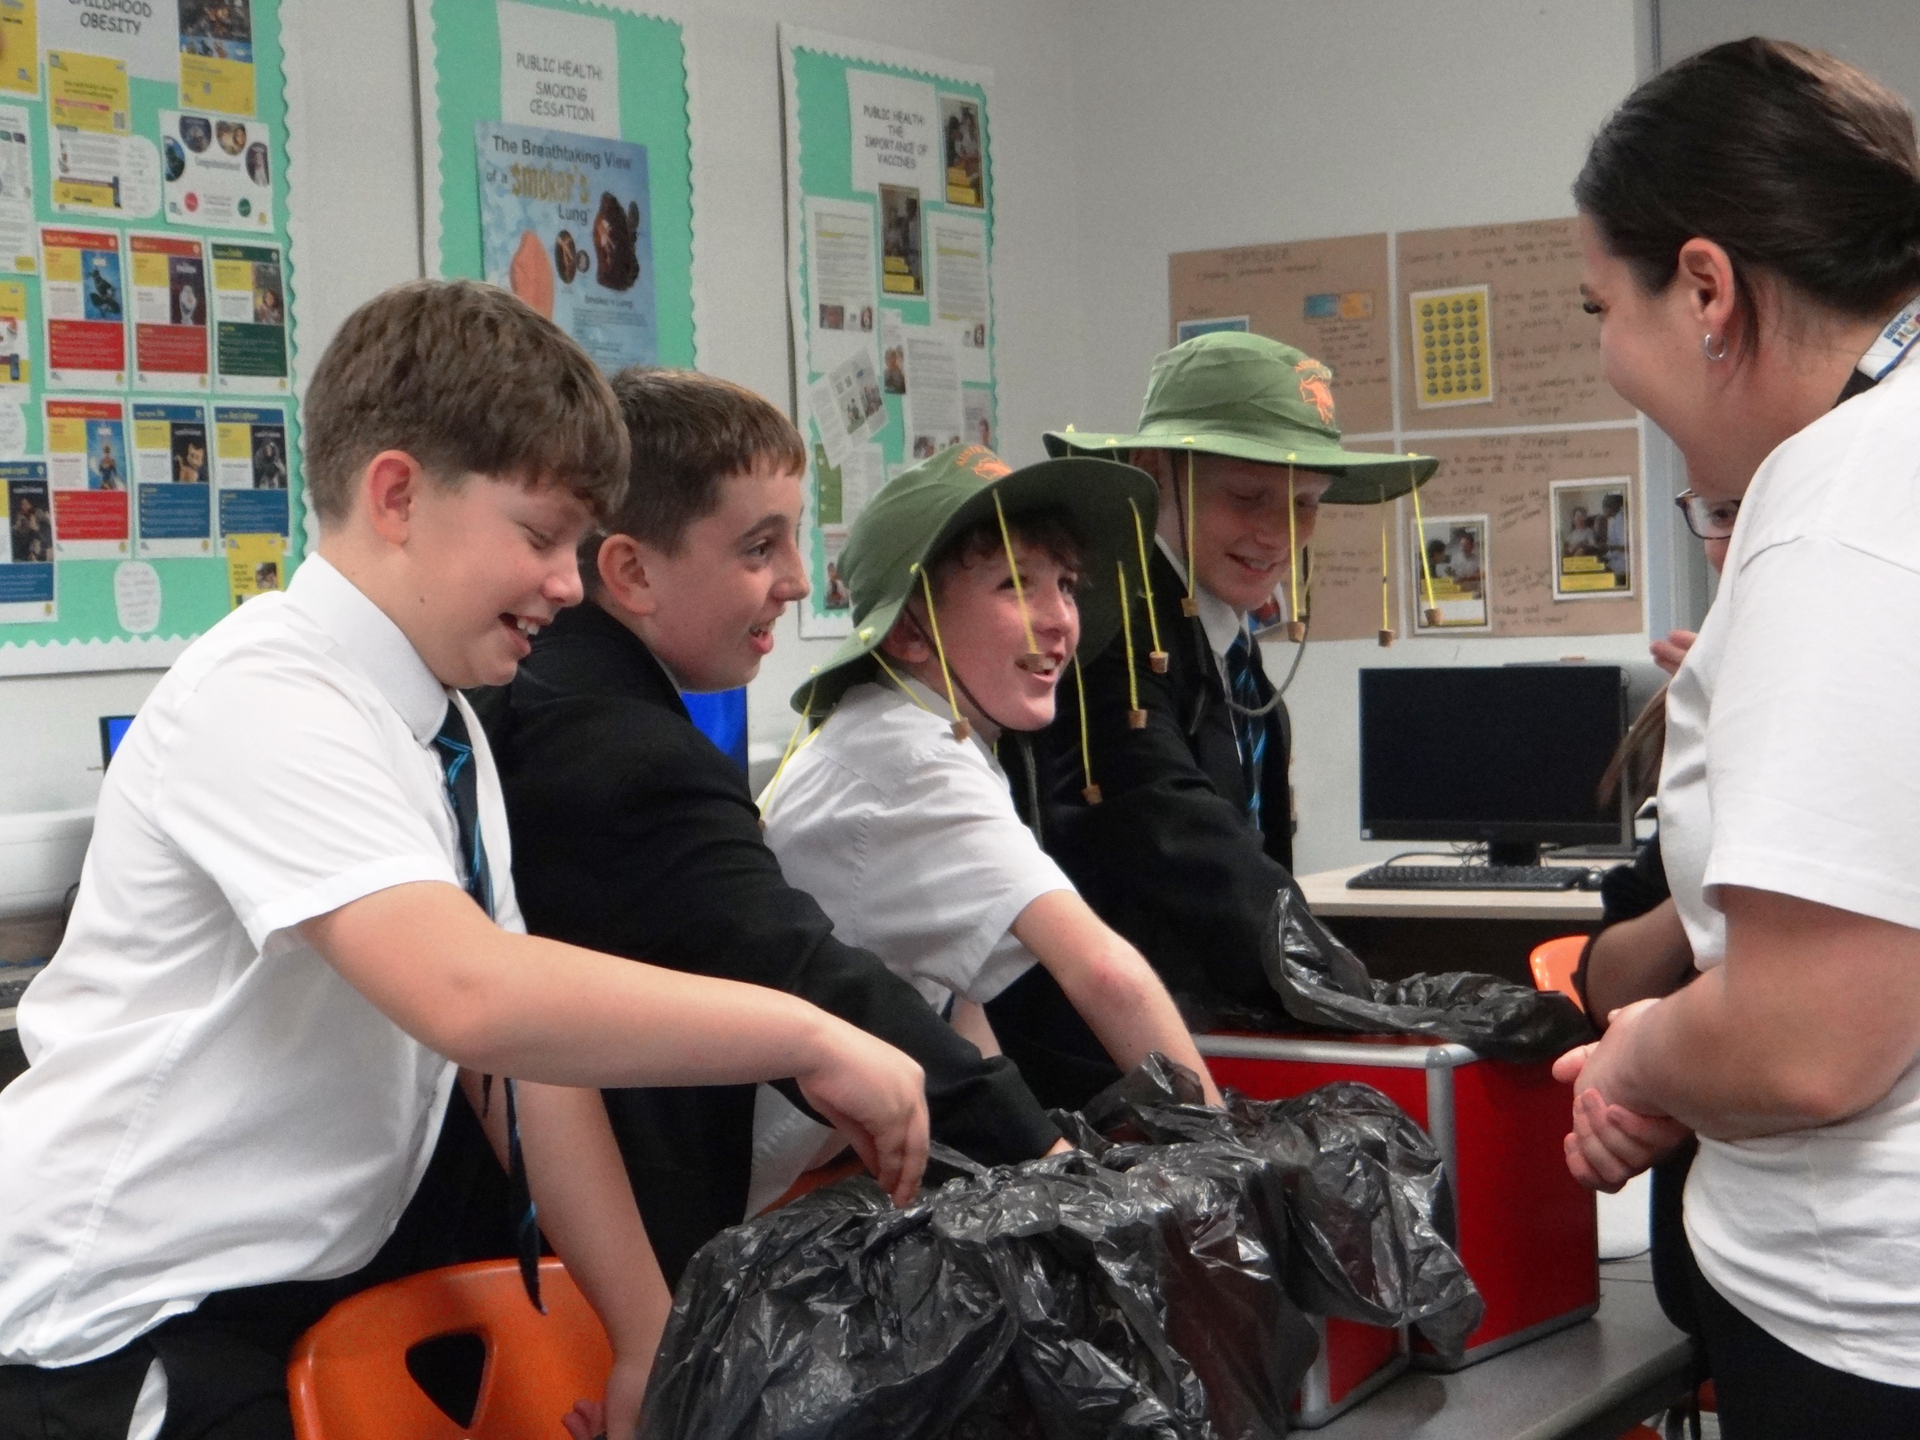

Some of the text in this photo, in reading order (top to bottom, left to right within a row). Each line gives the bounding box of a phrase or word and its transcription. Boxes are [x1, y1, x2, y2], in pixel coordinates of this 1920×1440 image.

[80, 12, 141, 35] OBESITY
[516, 52, 556, 73] PUBLIC
[535, 81, 588, 103] SMOKING
[529, 98, 595, 122] CESSATION
[863, 105, 890, 121] PUBLIC
[887, 124, 904, 139] THE
[492, 135, 632, 171] The Breathtaking View
[864, 135, 929, 157] IMPORTANCE OF
[877, 152, 917, 170] VACCINES
[486, 169, 498, 183] of
[500, 173, 508, 184] a
[557, 204, 588, 226] Lung
[1883, 313, 1911, 339] BEING
